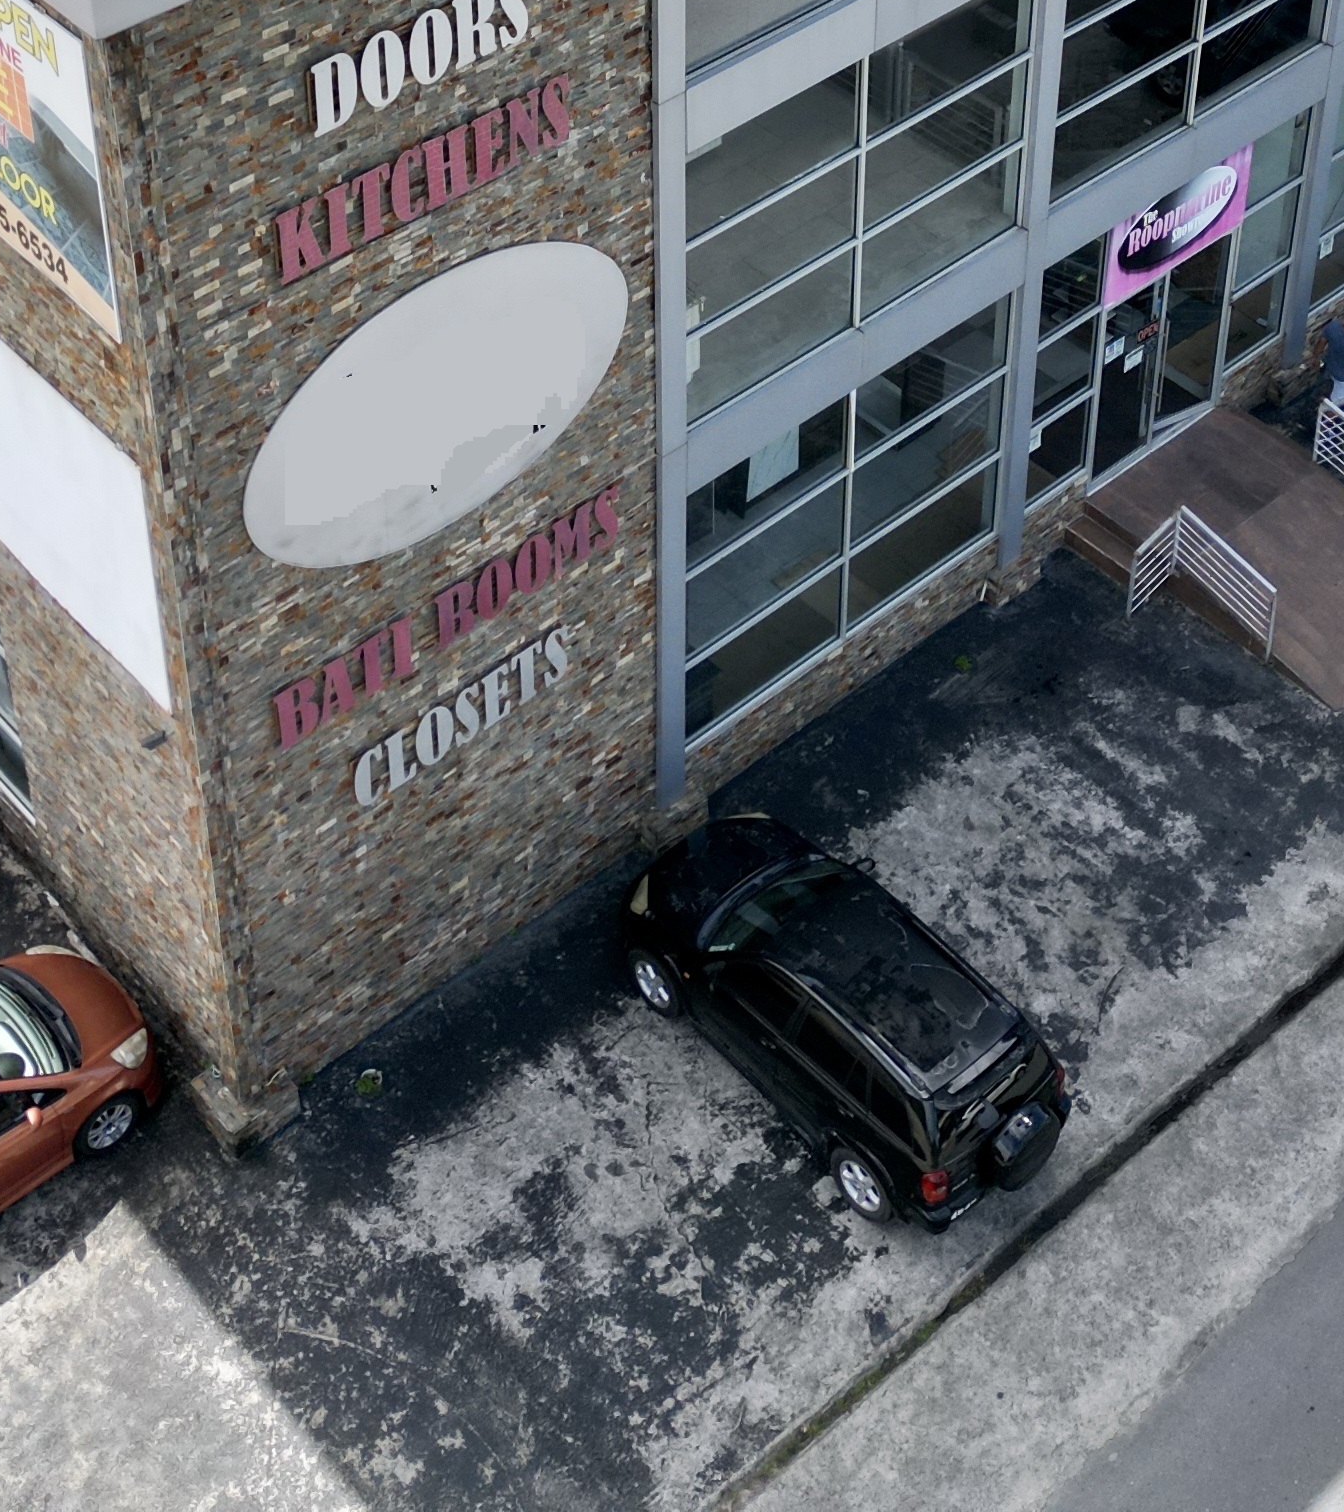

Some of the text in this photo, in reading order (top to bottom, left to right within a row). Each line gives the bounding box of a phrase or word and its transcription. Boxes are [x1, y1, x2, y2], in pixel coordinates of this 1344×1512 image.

[274, 73, 570, 286] KITCHENS
[434, 486, 621, 653] ROOMS
[353, 625, 571, 807] CLOSETS
